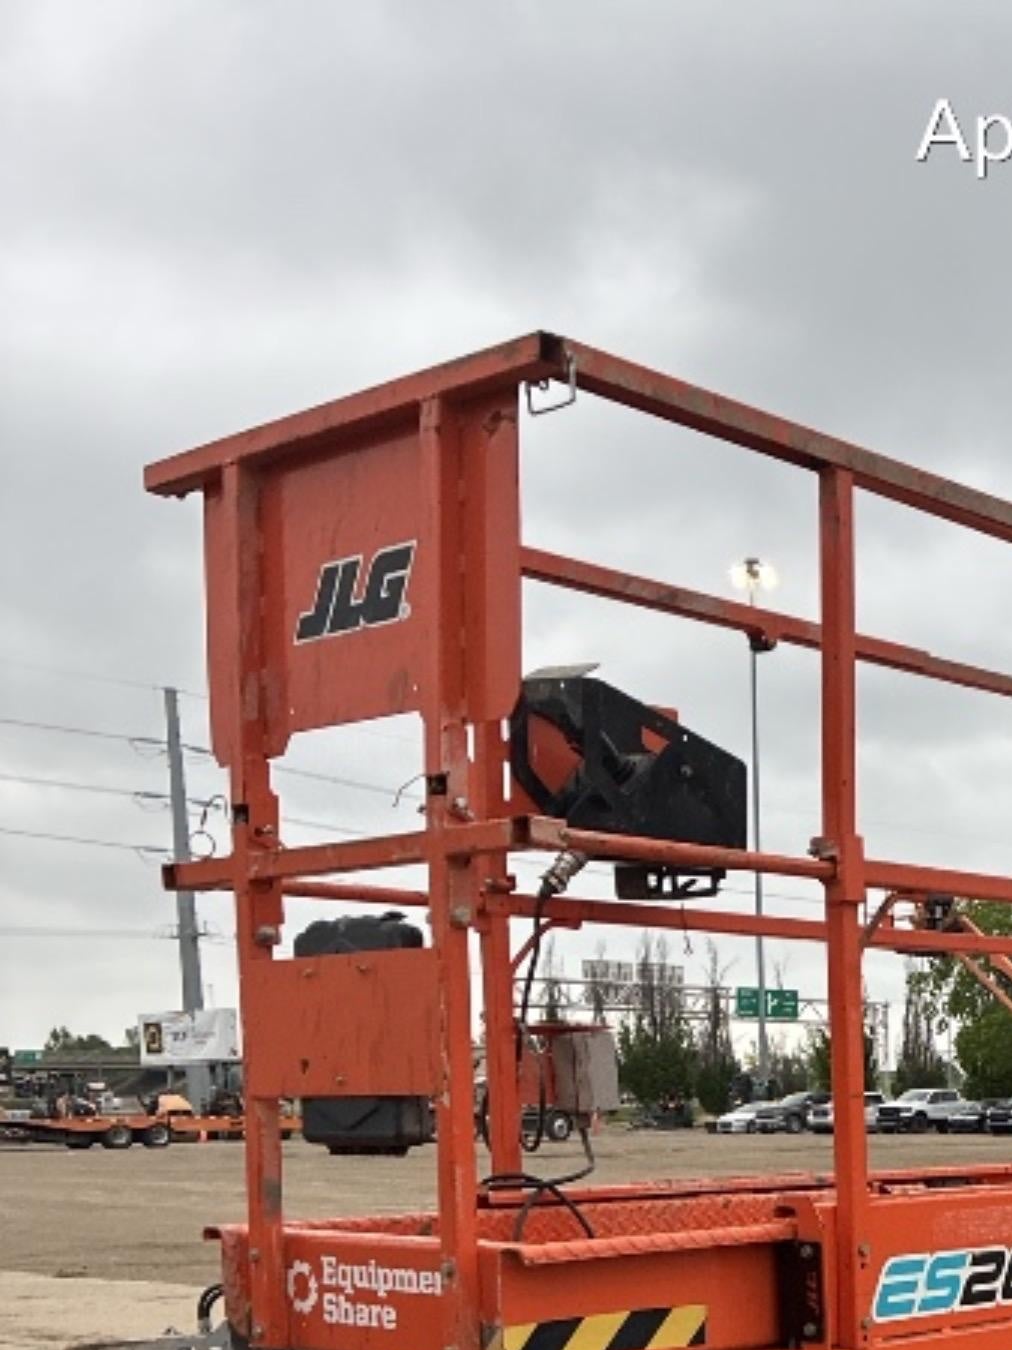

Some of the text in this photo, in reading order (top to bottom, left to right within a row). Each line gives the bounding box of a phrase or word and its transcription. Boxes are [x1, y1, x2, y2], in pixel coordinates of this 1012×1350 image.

[293, 540, 418, 645] JLG
[320, 1256, 443, 1298] Equipme
[322, 1293, 398, 1330] Share
